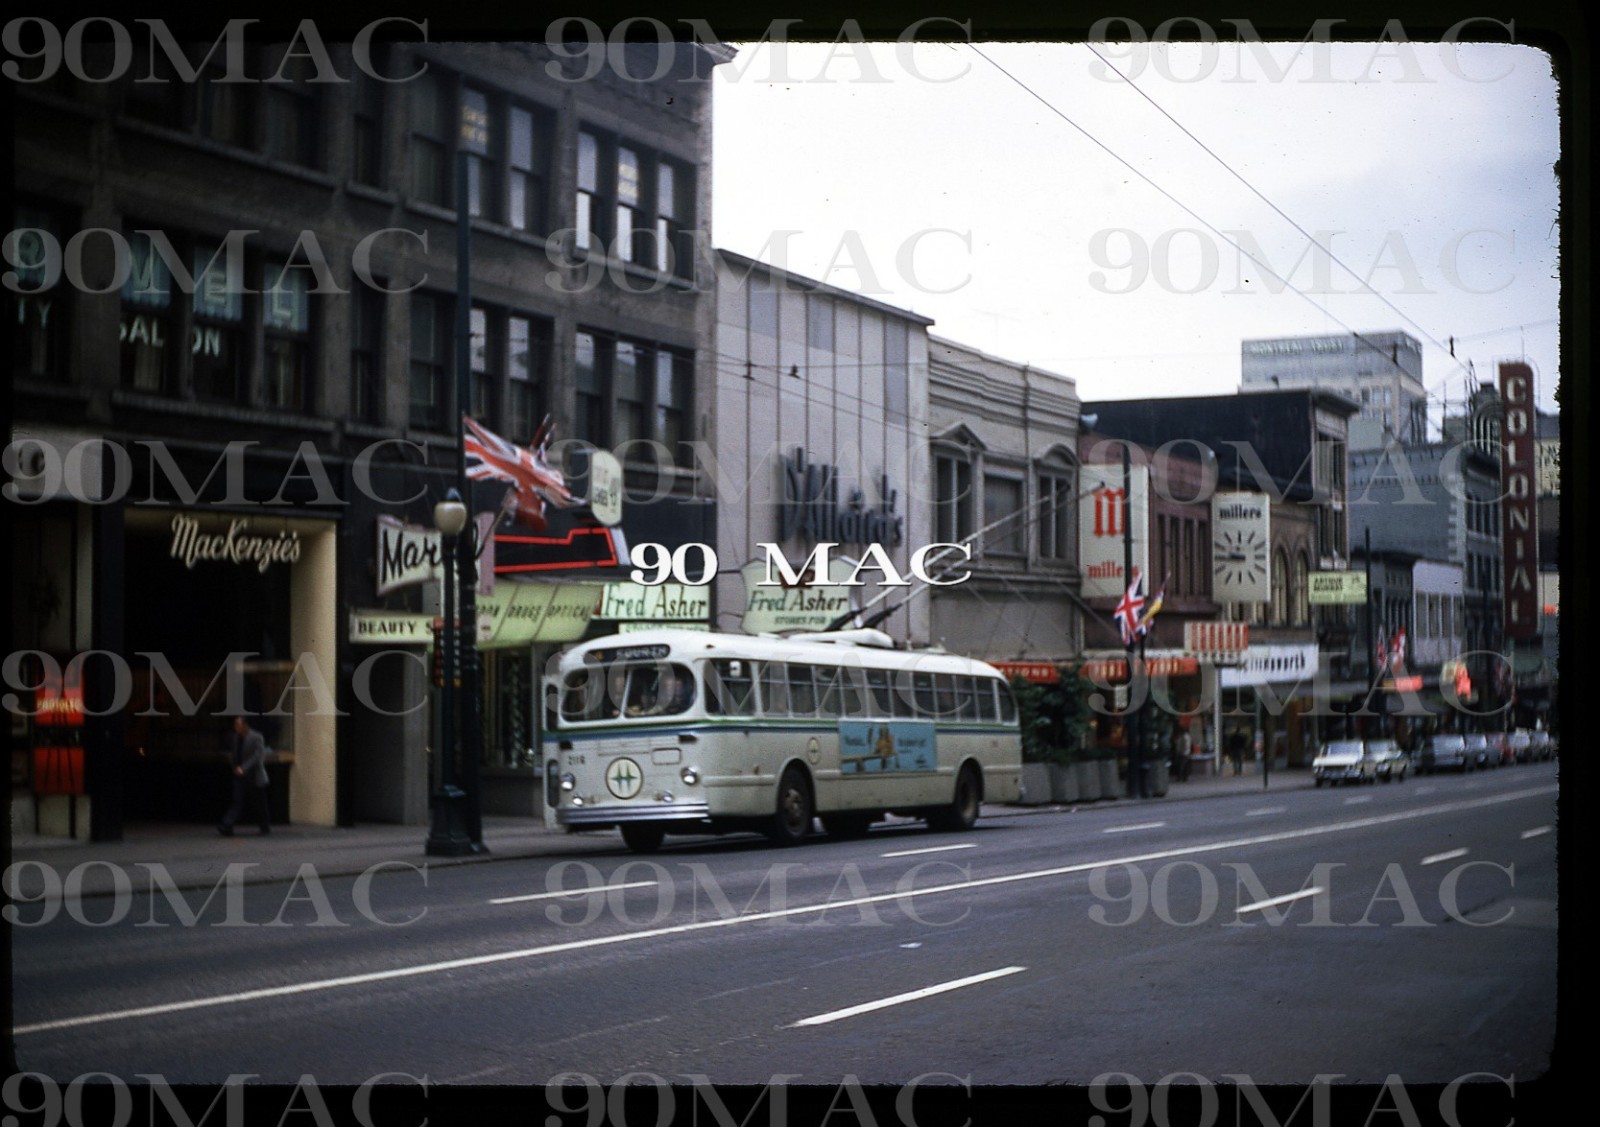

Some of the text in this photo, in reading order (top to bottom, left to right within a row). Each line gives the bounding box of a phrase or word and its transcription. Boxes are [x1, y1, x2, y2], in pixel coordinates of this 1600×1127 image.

[1219, 504, 1263, 520] millers
[1506, 377, 1532, 624] COLONIAL
[170, 513, 301, 574] MacKenzie's
[1088, 560, 1139, 578] milles
[603, 582, 708, 618] Fred Asher
[747, 588, 849, 612] Fred Asher
[357, 621, 418, 636] BEAUTY
